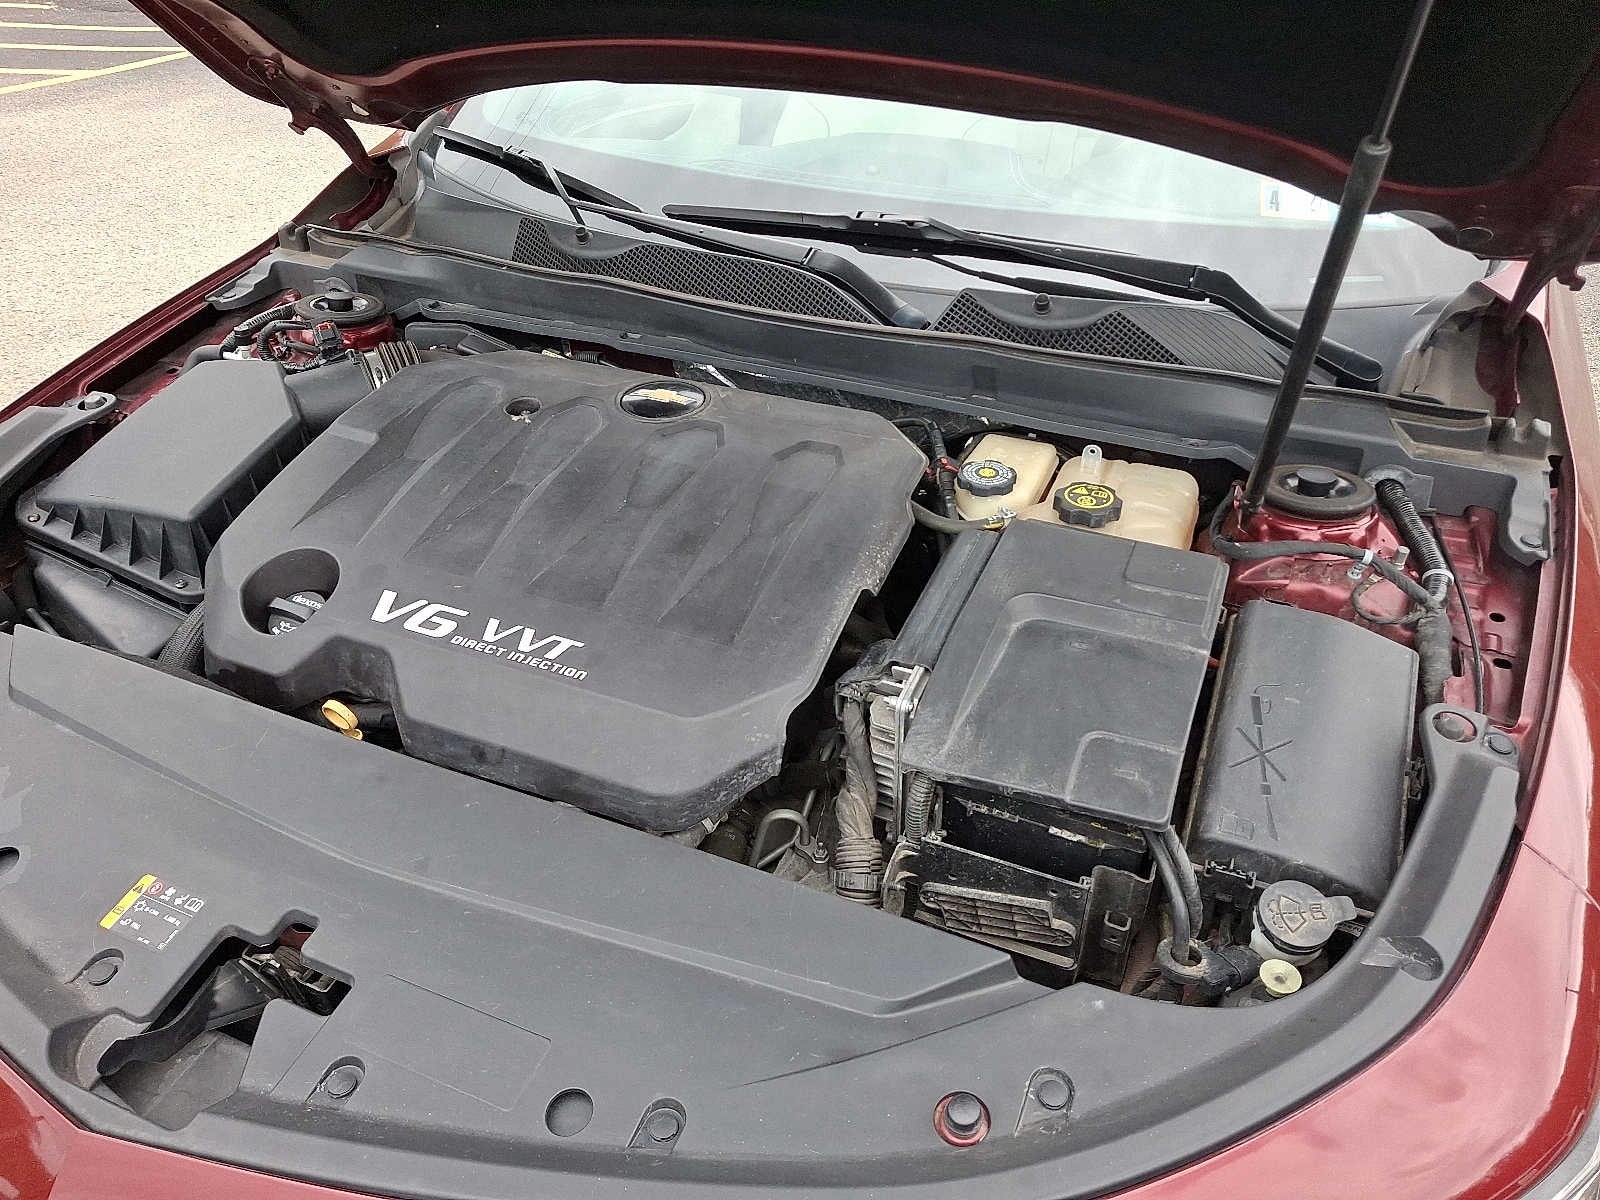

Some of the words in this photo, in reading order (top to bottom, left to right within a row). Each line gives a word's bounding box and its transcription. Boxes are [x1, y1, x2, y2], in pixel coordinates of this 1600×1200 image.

[371, 589, 470, 638] V6
[482, 617, 585, 660] VVT
[450, 635, 508, 657] DIRECT
[507, 650, 589, 681] INJECTION
